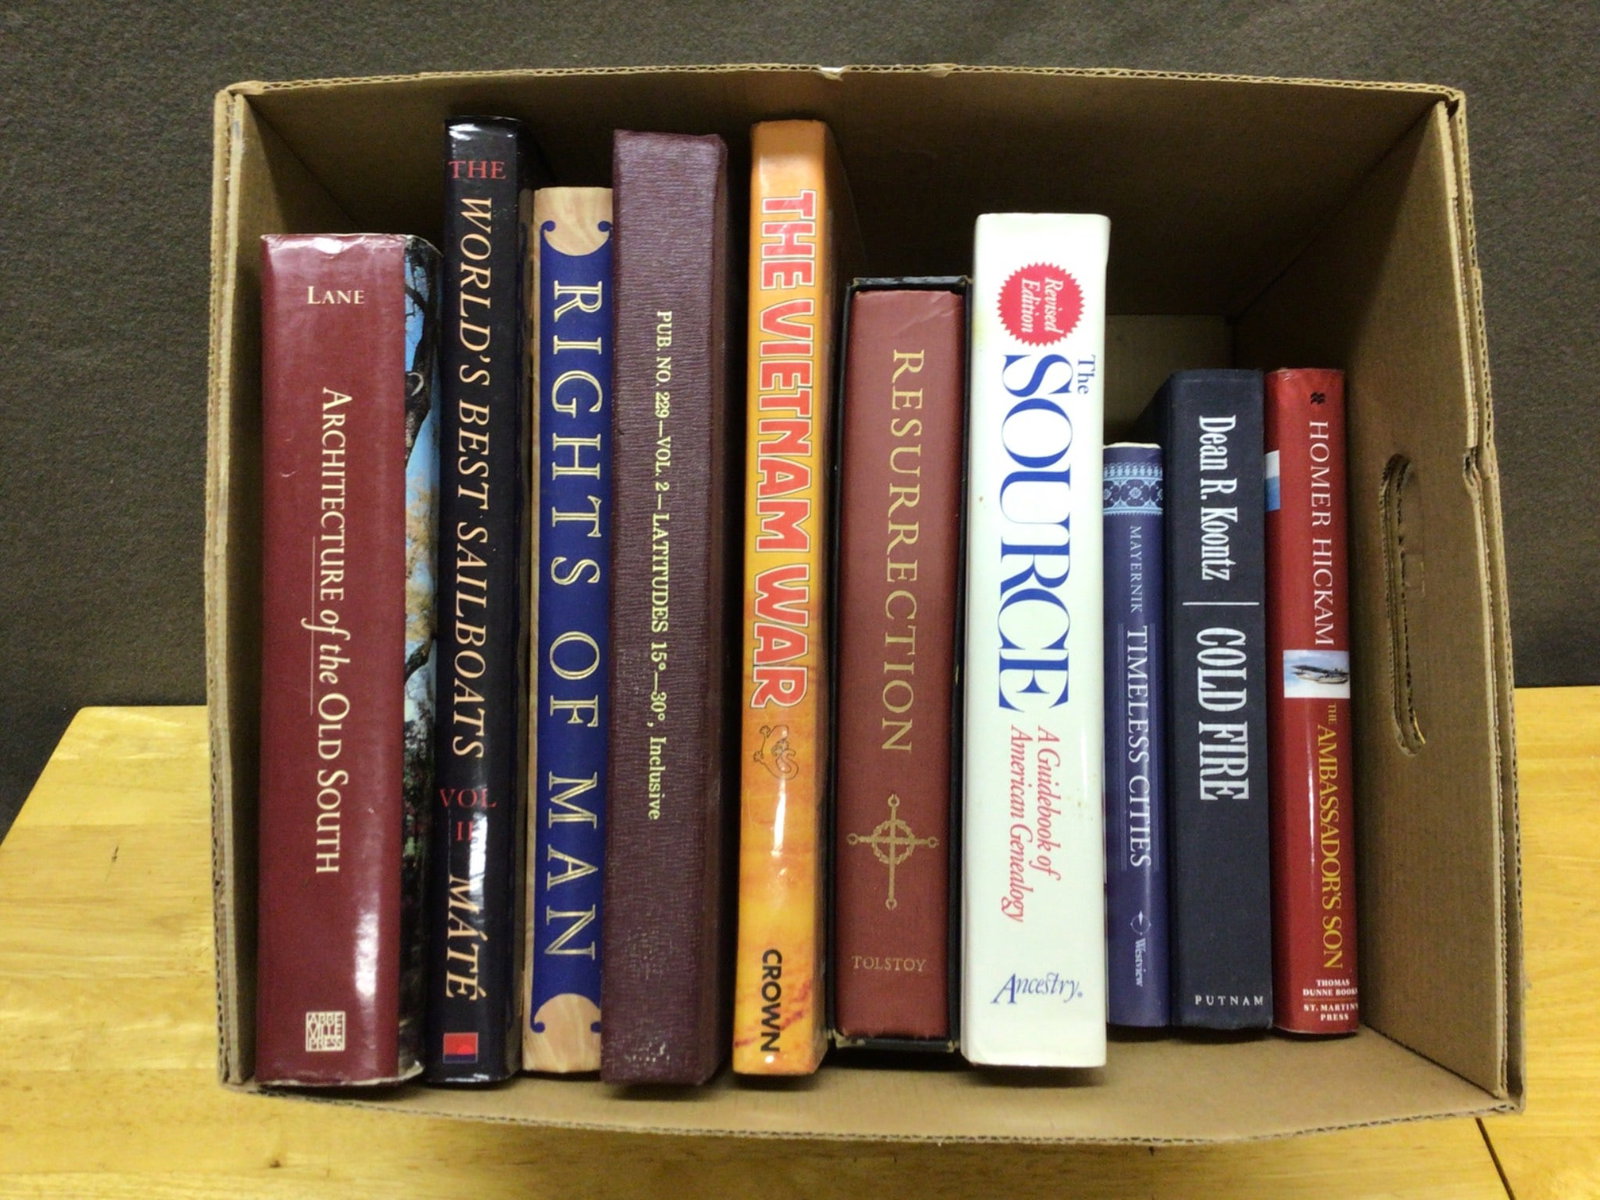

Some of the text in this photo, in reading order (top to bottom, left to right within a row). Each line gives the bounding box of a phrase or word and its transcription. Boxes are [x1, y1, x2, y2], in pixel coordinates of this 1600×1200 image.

[448, 160, 505, 179] THE
[308, 286, 363, 304] LANE
[657, 311, 672, 351] PUB.
[1021, 279, 1041, 333] Edition
[1044, 277, 1064, 335] Revised
[656, 357, 671, 386] NO.
[1077, 354, 1096, 395] The
[453, 198, 491, 758] WORLD'S BEST SAILBOATS
[751, 188, 816, 710] THE VIETNAM WAR
[997, 354, 1073, 713] SOURCE
[1200, 416, 1237, 580] Dean R. Koontz
[1310, 422, 1333, 644] HOMER HICKAM
[882, 349, 925, 754] RESURRECTION
[1130, 526, 1142, 612] MAYERNIK
[301, 387, 353, 874] ARCHITECTURE of the OLD SOUTH
[546, 280, 602, 959] RIGHTS OF MAN
[1126, 625, 1151, 868] TIMELESS CITIES
[1197, 628, 1248, 799] COLD FIRE
[1327, 703, 1337, 725] THE
[439, 787, 497, 808] VOL
[649, 737, 666, 819] Inclusive
[1034, 725, 1061, 880] A Guidebook of
[1001, 725, 1036, 922] American Genealogy
[1318, 725, 1342, 967] AMBASSADOR'S SON
[445, 873, 488, 1000] MÁTÉ
[851, 956, 926, 973] TOLSTOY
[1134, 938, 1147, 987] Westview
[761, 948, 782, 1053] CROWN
[1195, 995, 1263, 1005] PUTNAM
[1303, 988, 1333, 996] DUNNE
[1303, 1004, 1319, 1012] ST.
[1315, 979, 1350, 987] THOMAS
[1320, 1013, 1349, 1021] PRESS
